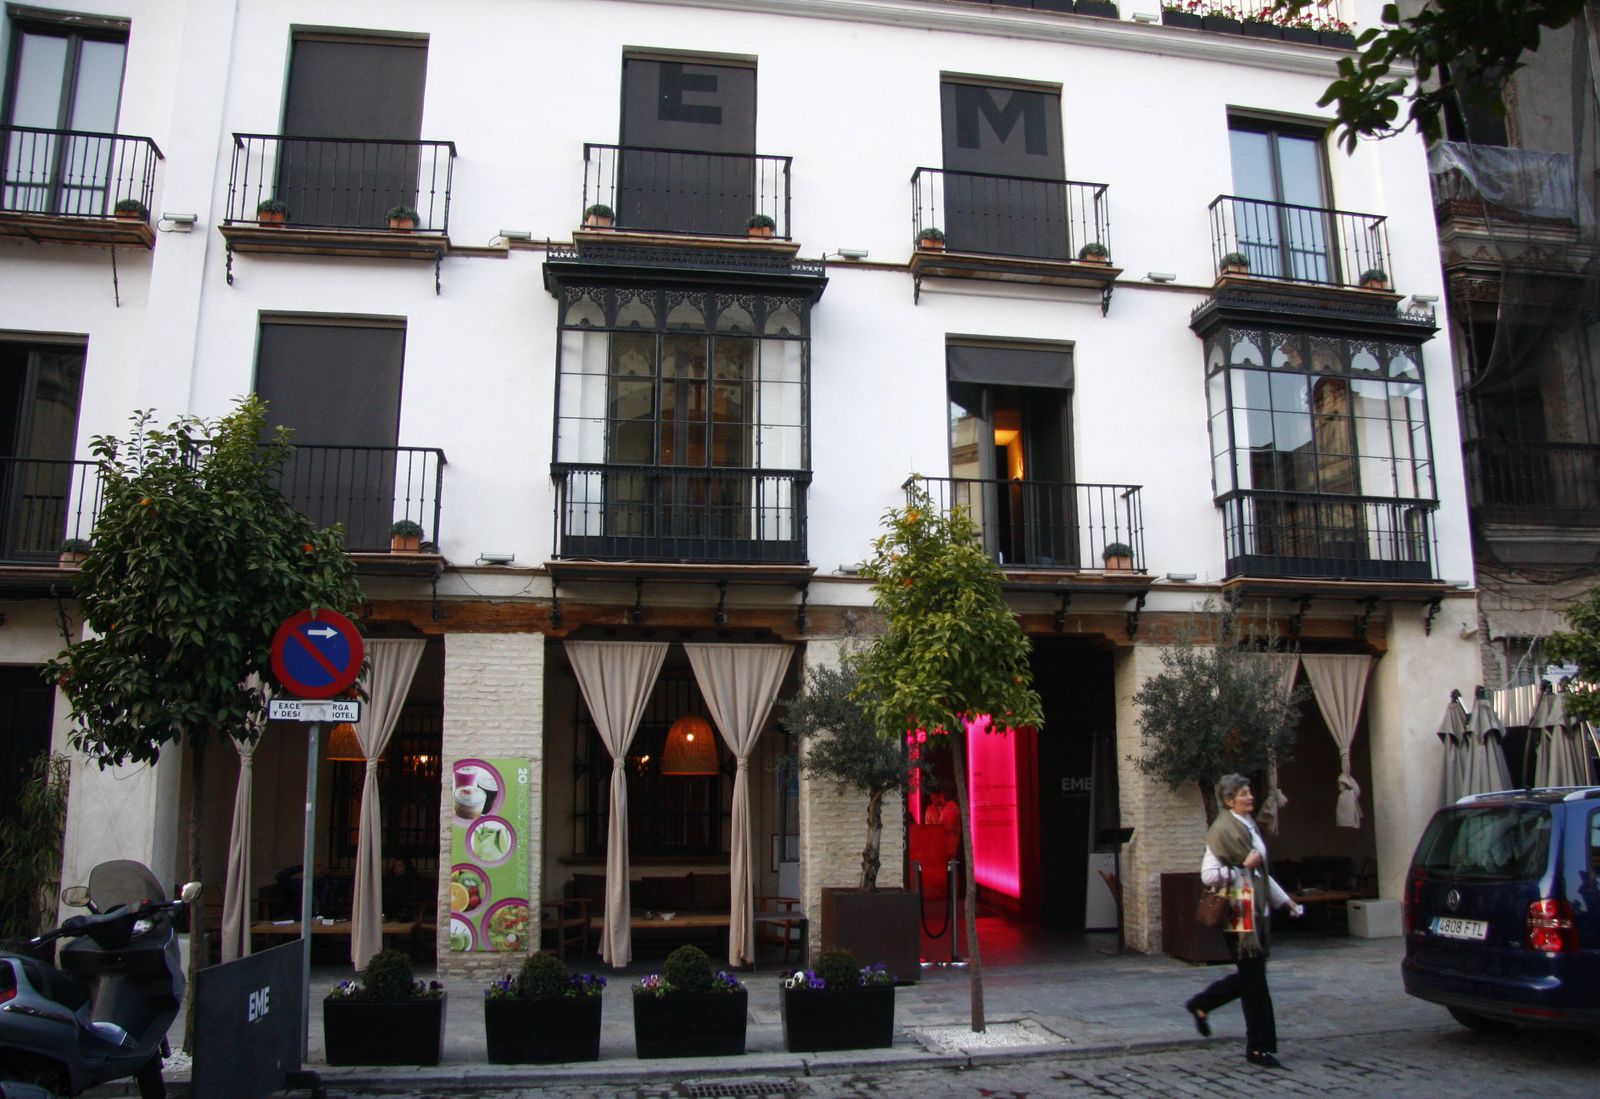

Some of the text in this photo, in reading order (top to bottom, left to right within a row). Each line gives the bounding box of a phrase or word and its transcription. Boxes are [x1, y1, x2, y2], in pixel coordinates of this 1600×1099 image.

[955, 85, 1048, 157] M
[278, 702, 300, 710] EXCE
[1061, 777, 1093, 791] EME
[1439, 919, 1484, 937] 4808 FTL
[249, 985, 271, 1022] EME
